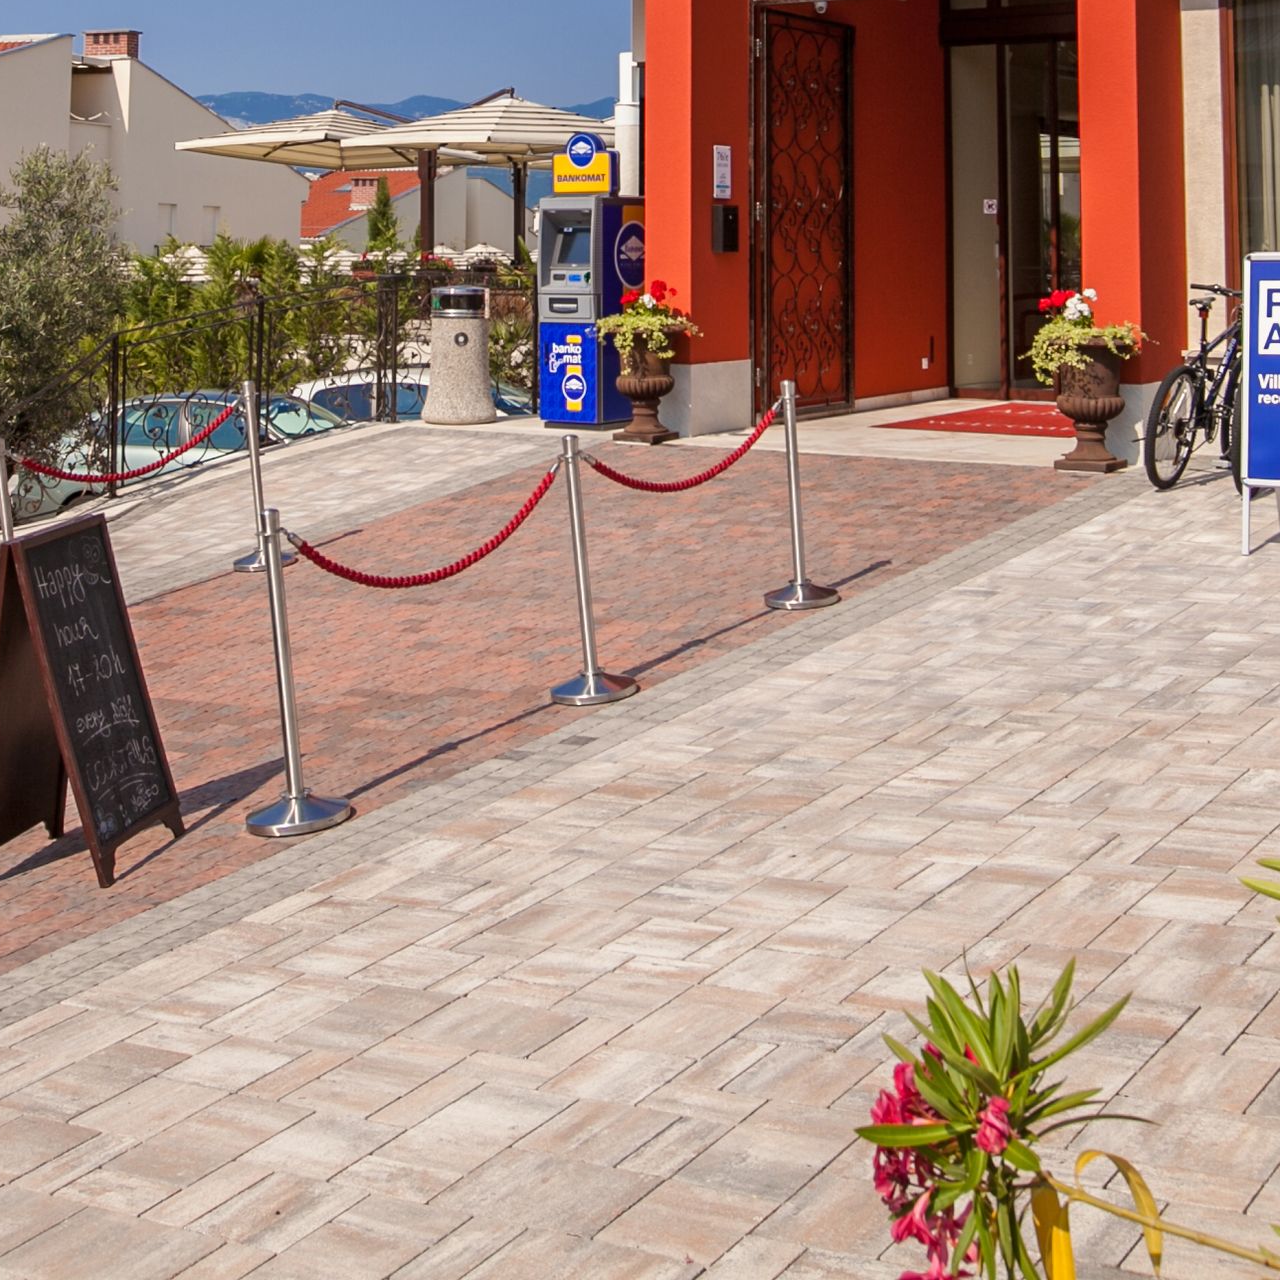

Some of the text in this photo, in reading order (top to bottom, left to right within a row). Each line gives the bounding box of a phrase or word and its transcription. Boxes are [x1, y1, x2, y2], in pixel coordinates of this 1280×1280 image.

[556, 173, 606, 183] BANKOMAT
[552, 342, 582, 354] banko
[562, 354, 582, 364] mat
[33, 563, 86, 608] Happy
